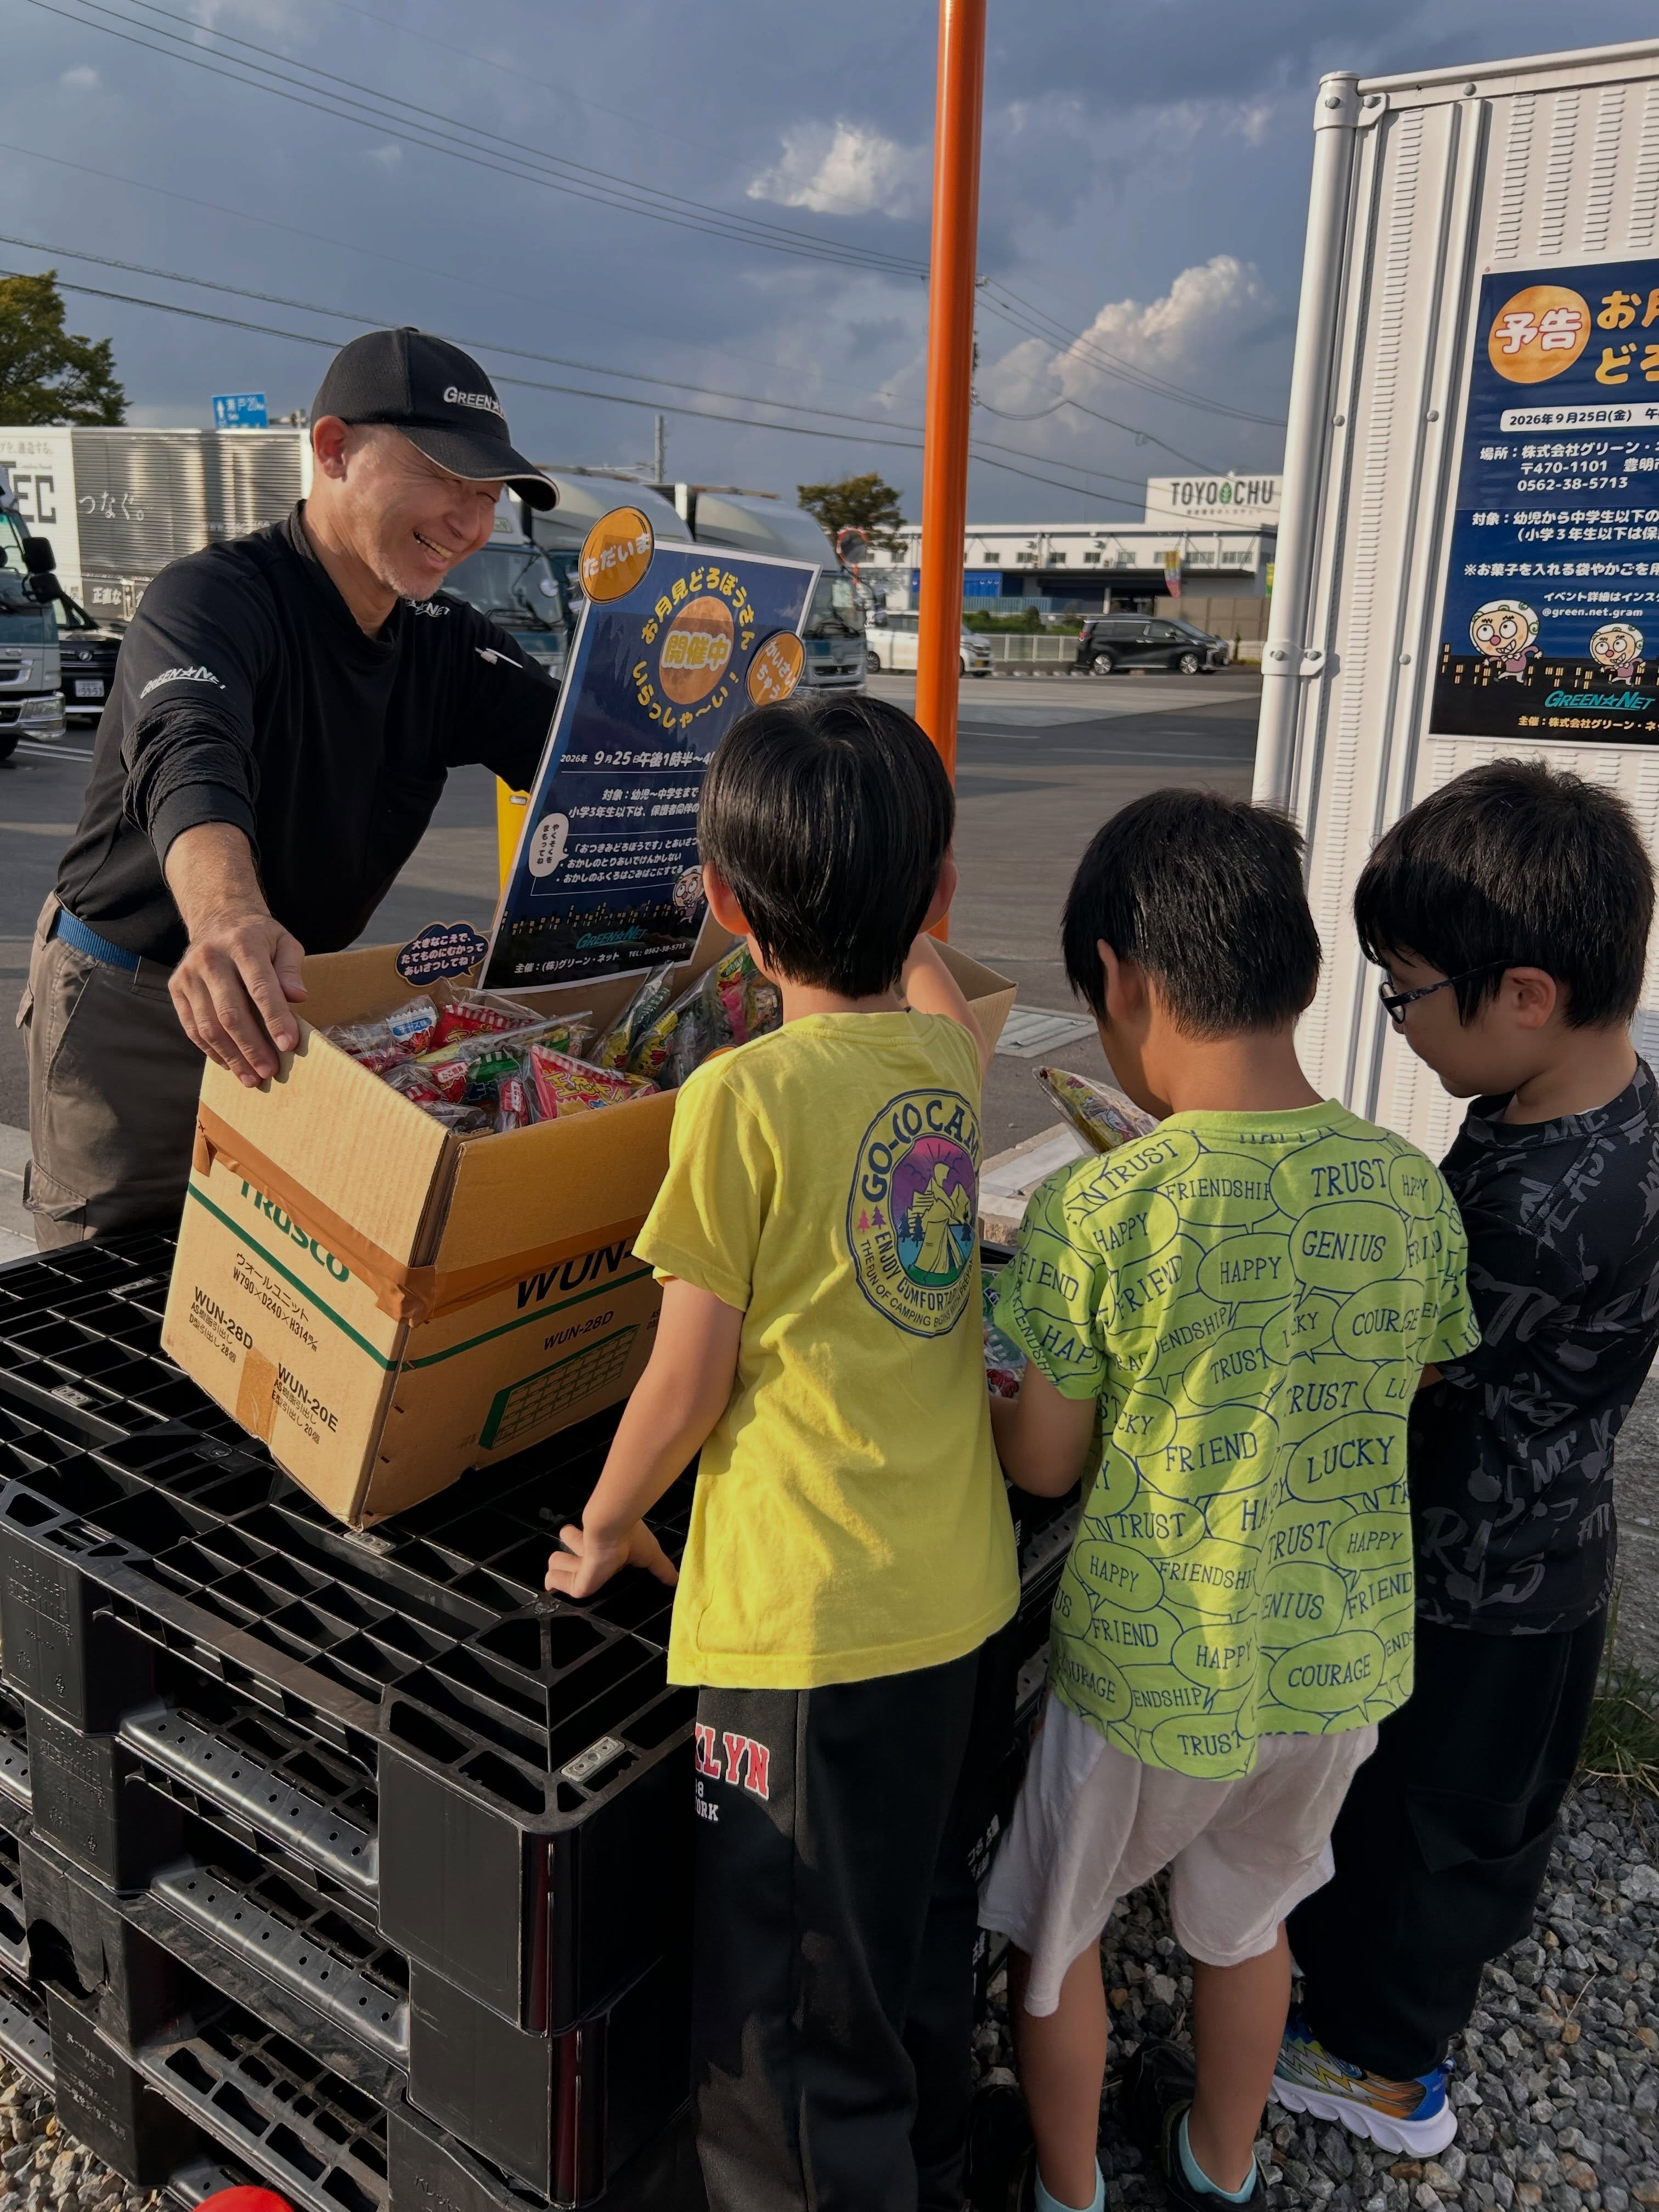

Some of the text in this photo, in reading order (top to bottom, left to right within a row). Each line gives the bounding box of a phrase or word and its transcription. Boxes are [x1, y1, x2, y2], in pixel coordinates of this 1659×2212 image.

[1495, 308, 1582, 353] 予告
[1645, 408, 1659, 421] 午
[1520, 459, 1607, 475] 〒470-1101
[1517, 476, 1628, 492] 0562-38-5713
[78, 492, 145, 522] つなぐ。
[1517, 526, 1659, 543] (小学3年生以下は保
[583, 533, 652, 578] ただいま
[641, 567, 755, 651] お月見どろぼうさん
[1542, 607, 1643, 619] @green.net.gram
[662, 632, 730, 670] 開催中
[1518, 716, 1659, 731] 主催：株式会社グリーン・ネ
[560, 754, 589, 764] 2026年
[537, 825, 550, 865] まもってね
[546, 823, 560, 864] やくそくを
[401, 943, 484, 965] たてものにむかって
[411, 933, 471, 951] 大きなこえで、
[644, 942, 686, 956] 0562-38-5713
[1097, 1139, 1178, 1192] TRUST
[1311, 1158, 1387, 1198] TRUST
[1093, 1212, 1149, 1253] HAPPY
[1302, 1230, 1387, 1263] GENIUS
[860, 1239, 874, 1262] THE
[874, 1231, 901, 1280] ENJOY
[865, 1263, 879, 1286] FUN
[1220, 1256, 1282, 1285] HAPPY
[876, 1284, 891, 1299] OF
[1114, 1255, 1183, 1321] FRIEND
[194, 1286, 253, 1350] WUN-28D
[889, 1297, 932, 1327] CAMPING
[543, 1310, 614, 1351] WUN-28D
[277, 1362, 338, 1433] WUN-20E
[1165, 1431, 1257, 1472] FRIEND
[1307, 1435, 1395, 1484] LUCKY
[1116, 1512, 1186, 1539] TRUST
[1347, 1531, 1404, 1554] HAPPY
[1090, 1555, 1140, 1593] HAPPY
[1345, 1571, 1413, 1620] FRIEND
[1091, 1617, 1159, 1647] FRIEND
[1195, 1637, 1252, 1670] HAPPY
[1287, 1654, 1372, 1689] COURAGE
[1177, 1732, 1243, 1757] TRUST
